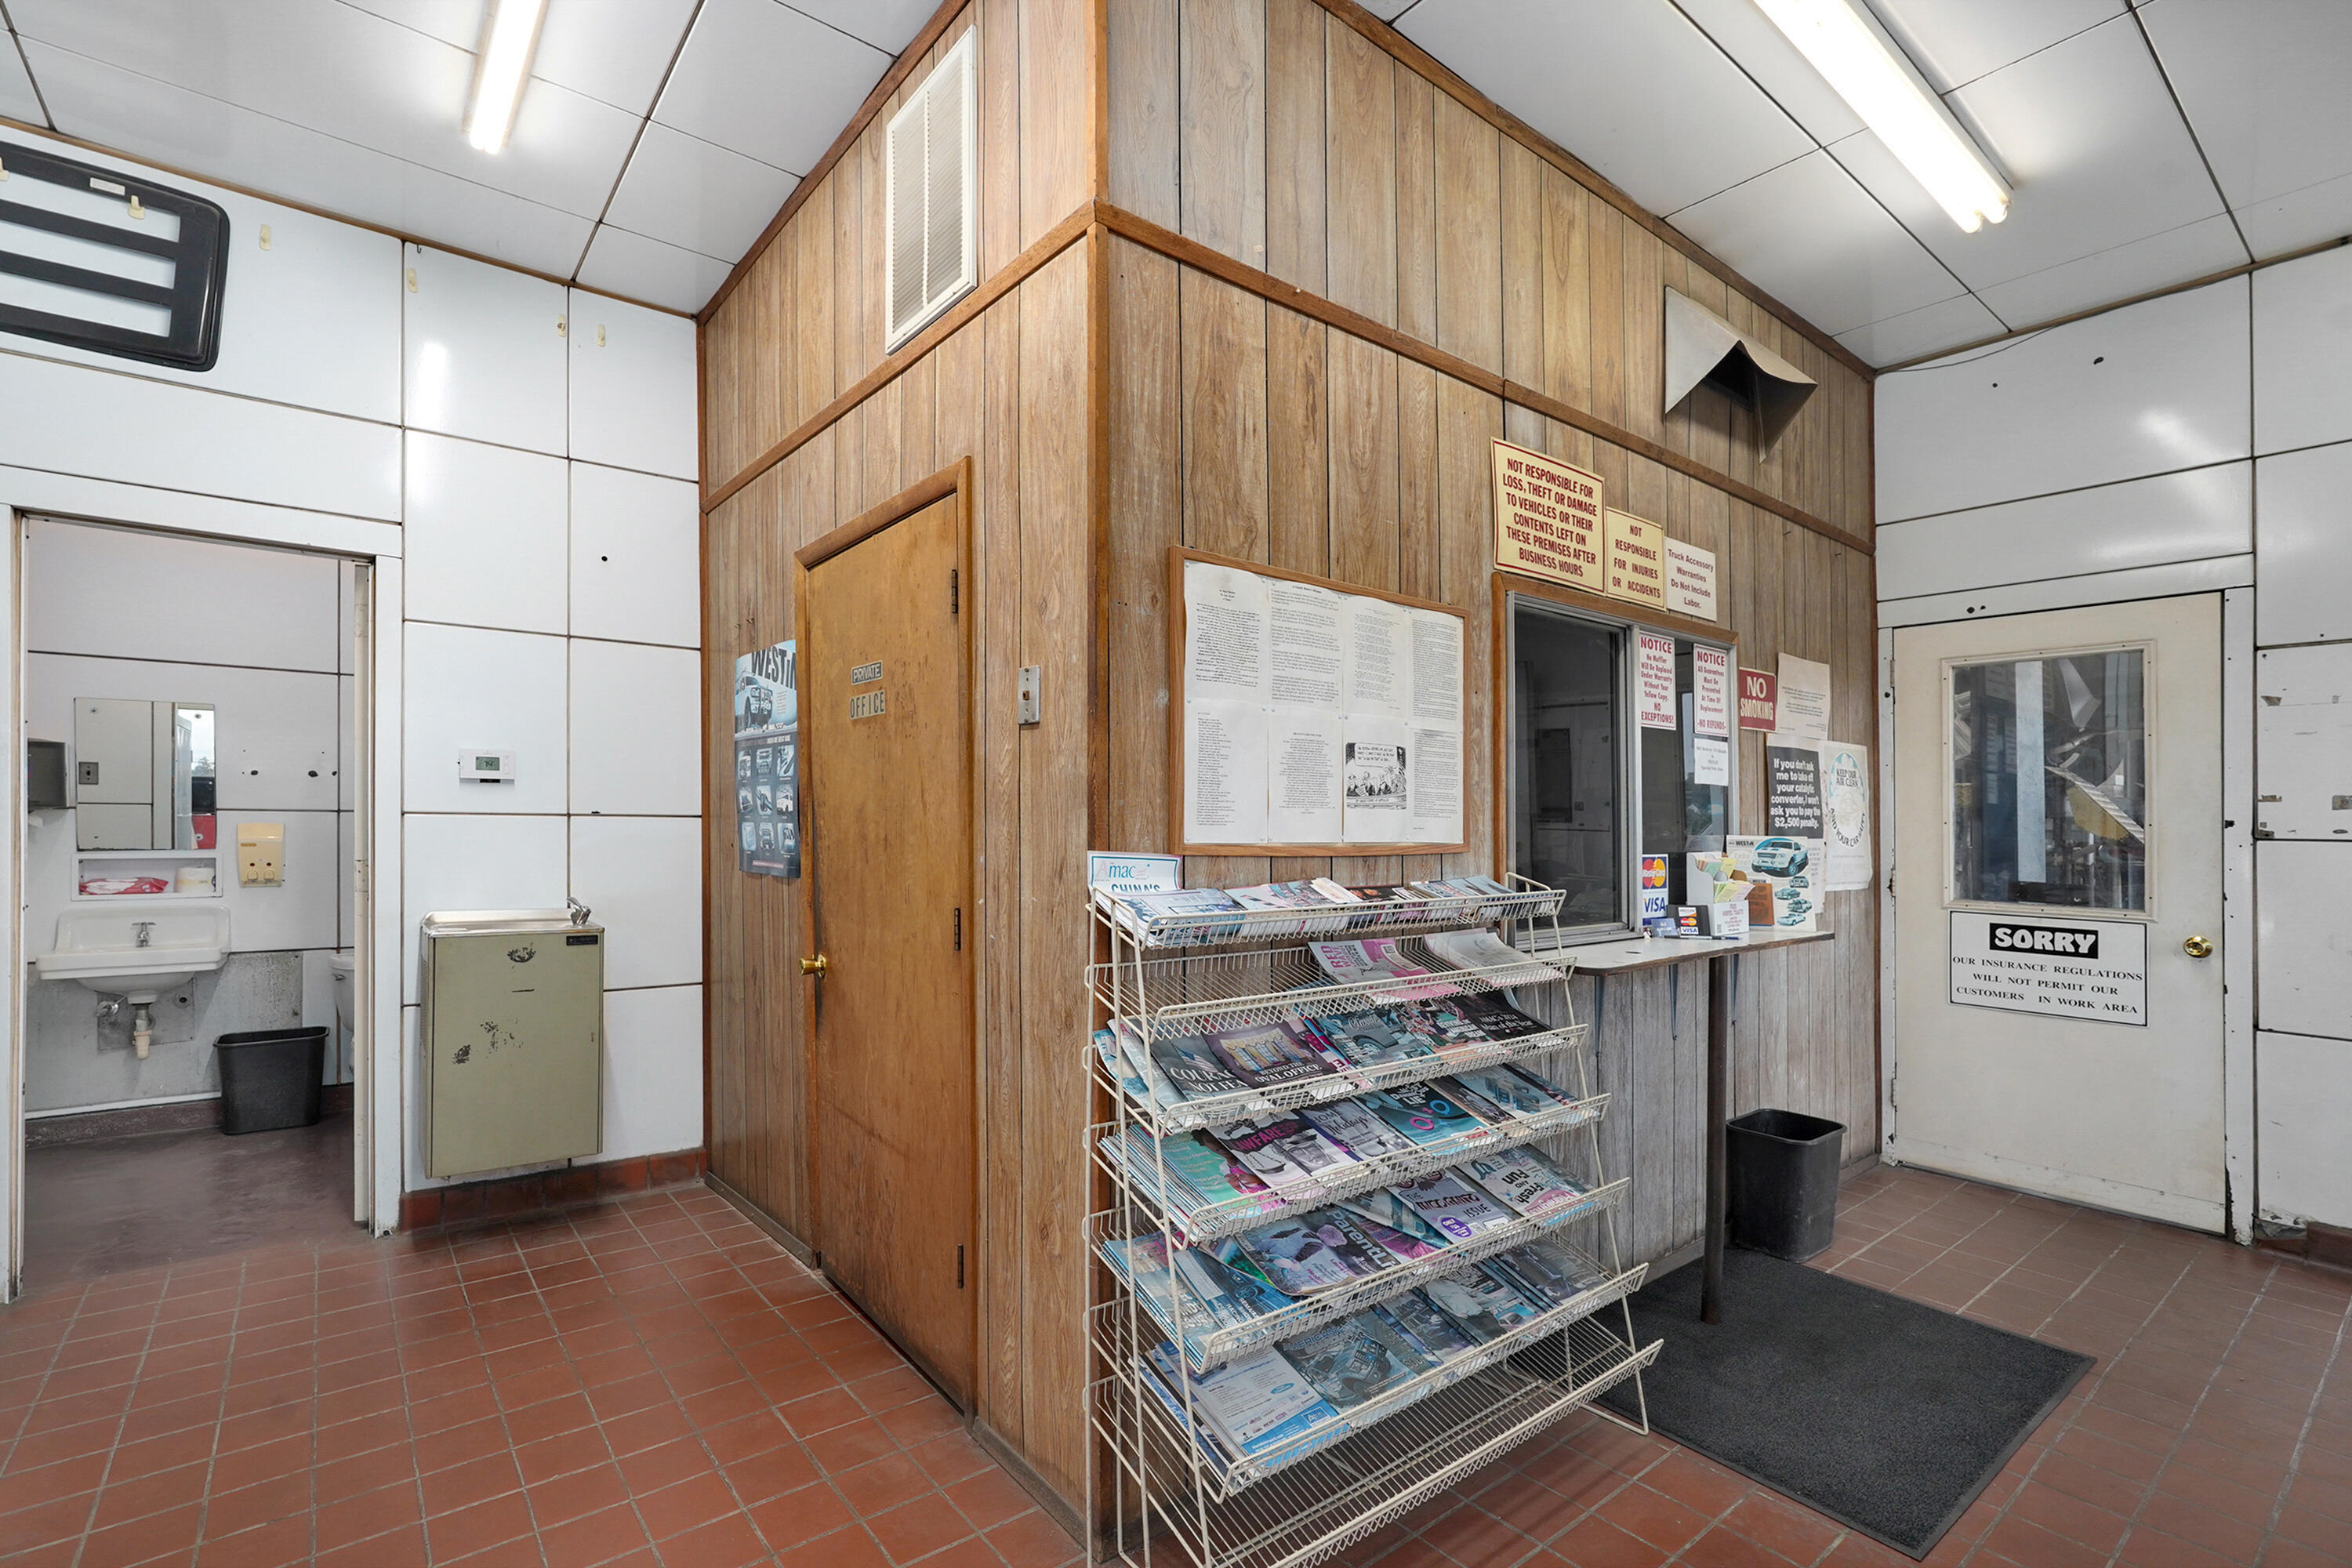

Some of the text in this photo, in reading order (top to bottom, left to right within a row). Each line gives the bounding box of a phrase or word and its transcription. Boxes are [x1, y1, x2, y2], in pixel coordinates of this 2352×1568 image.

[1508, 458, 1593, 499] NOT RESPONSIBLE FOR
[1503, 474, 1597, 516] LOSS, THEFT OR DAMAGE
[1506, 492, 1593, 532] TO VEHICLES OR THEIR
[1514, 513, 1586, 546] CONTENTS LEFT ON
[1630, 524, 1642, 537] NOT
[1506, 525, 1595, 564] THESE PREMISES AFTER
[1615, 539, 1657, 561] RESPONSIBLE
[1519, 547, 1583, 577] BUSINESS HOURS
[1614, 557, 1658, 579] FOR INJURIES
[1668, 549, 1713, 572] Truck Accessory
[1676, 565, 1706, 582] Warranties
[1613, 576, 1661, 598] OR ACCIDENTS
[1671, 579, 1711, 597] Do Not Include
[1684, 597, 1700, 608] Labor.
[1641, 637, 1671, 654] NOTICE
[1697, 651, 1725, 666] NOTICE
[853, 663, 880, 682] PRIVATE
[1656, 665, 1672, 674] Replaced
[1644, 681, 1660, 689] Without
[1654, 673, 1672, 684] Warranty
[1747, 676, 1766, 698] NO
[1644, 690, 1657, 699] Yellow
[1702, 685, 1721, 694] Presented
[850, 691, 884, 718] OFFICE
[1654, 702, 1661, 712] NO
[1700, 704, 1723, 713] Replacement
[1740, 697, 1773, 720] SMOKING
[1641, 711, 1674, 724] EXCEPTIONS!
[1773, 758, 1780, 768] If
[1780, 760, 1795, 771] you
[1796, 760, 1806, 770] don't
[1776, 771, 1789, 780] me
[1790, 771, 1798, 781] to
[1798, 772, 1807, 782] take
[1845, 778, 1859, 787] CLEAN
[1777, 783, 1815, 794] your catalytic
[1771, 796, 1805, 806] converter,
[1808, 796, 1819, 805] won't
[1770, 806, 1784, 815] ask
[1785, 808, 1798, 817] you
[1799, 807, 1805, 816] to
[1774, 817, 1819, 829] $2,500 penalty.
[1836, 830, 1849, 847] YOUR
[1850, 836, 1860, 848] CAR
[1643, 897, 1666, 913] VISA
[1994, 927, 2096, 953] SORRY
[1321, 946, 1344, 967] RED
[1952, 956, 2143, 981] OUR INSURANCE REGULATIONS
[1973, 973, 2118, 995] WILL NOT PERMIT OUR
[1956, 986, 2137, 1014] CUSTOMERS IN WORK AREA
[1254, 1063, 1323, 1083] OVAL OFFICE
[1189, 1080, 1220, 1092] NOT
[1403, 1094, 1426, 1105] LIE
[1325, 1116, 1368, 1135] Holidays
[1230, 1127, 1283, 1150] LAWFARE
[1501, 1169, 1530, 1185] Fun
[1515, 1180, 1529, 1189] AND
[1406, 1192, 1423, 1202] THE
[1517, 1182, 1544, 1204] Fresh
[1463, 1203, 1491, 1218] ISSUE
